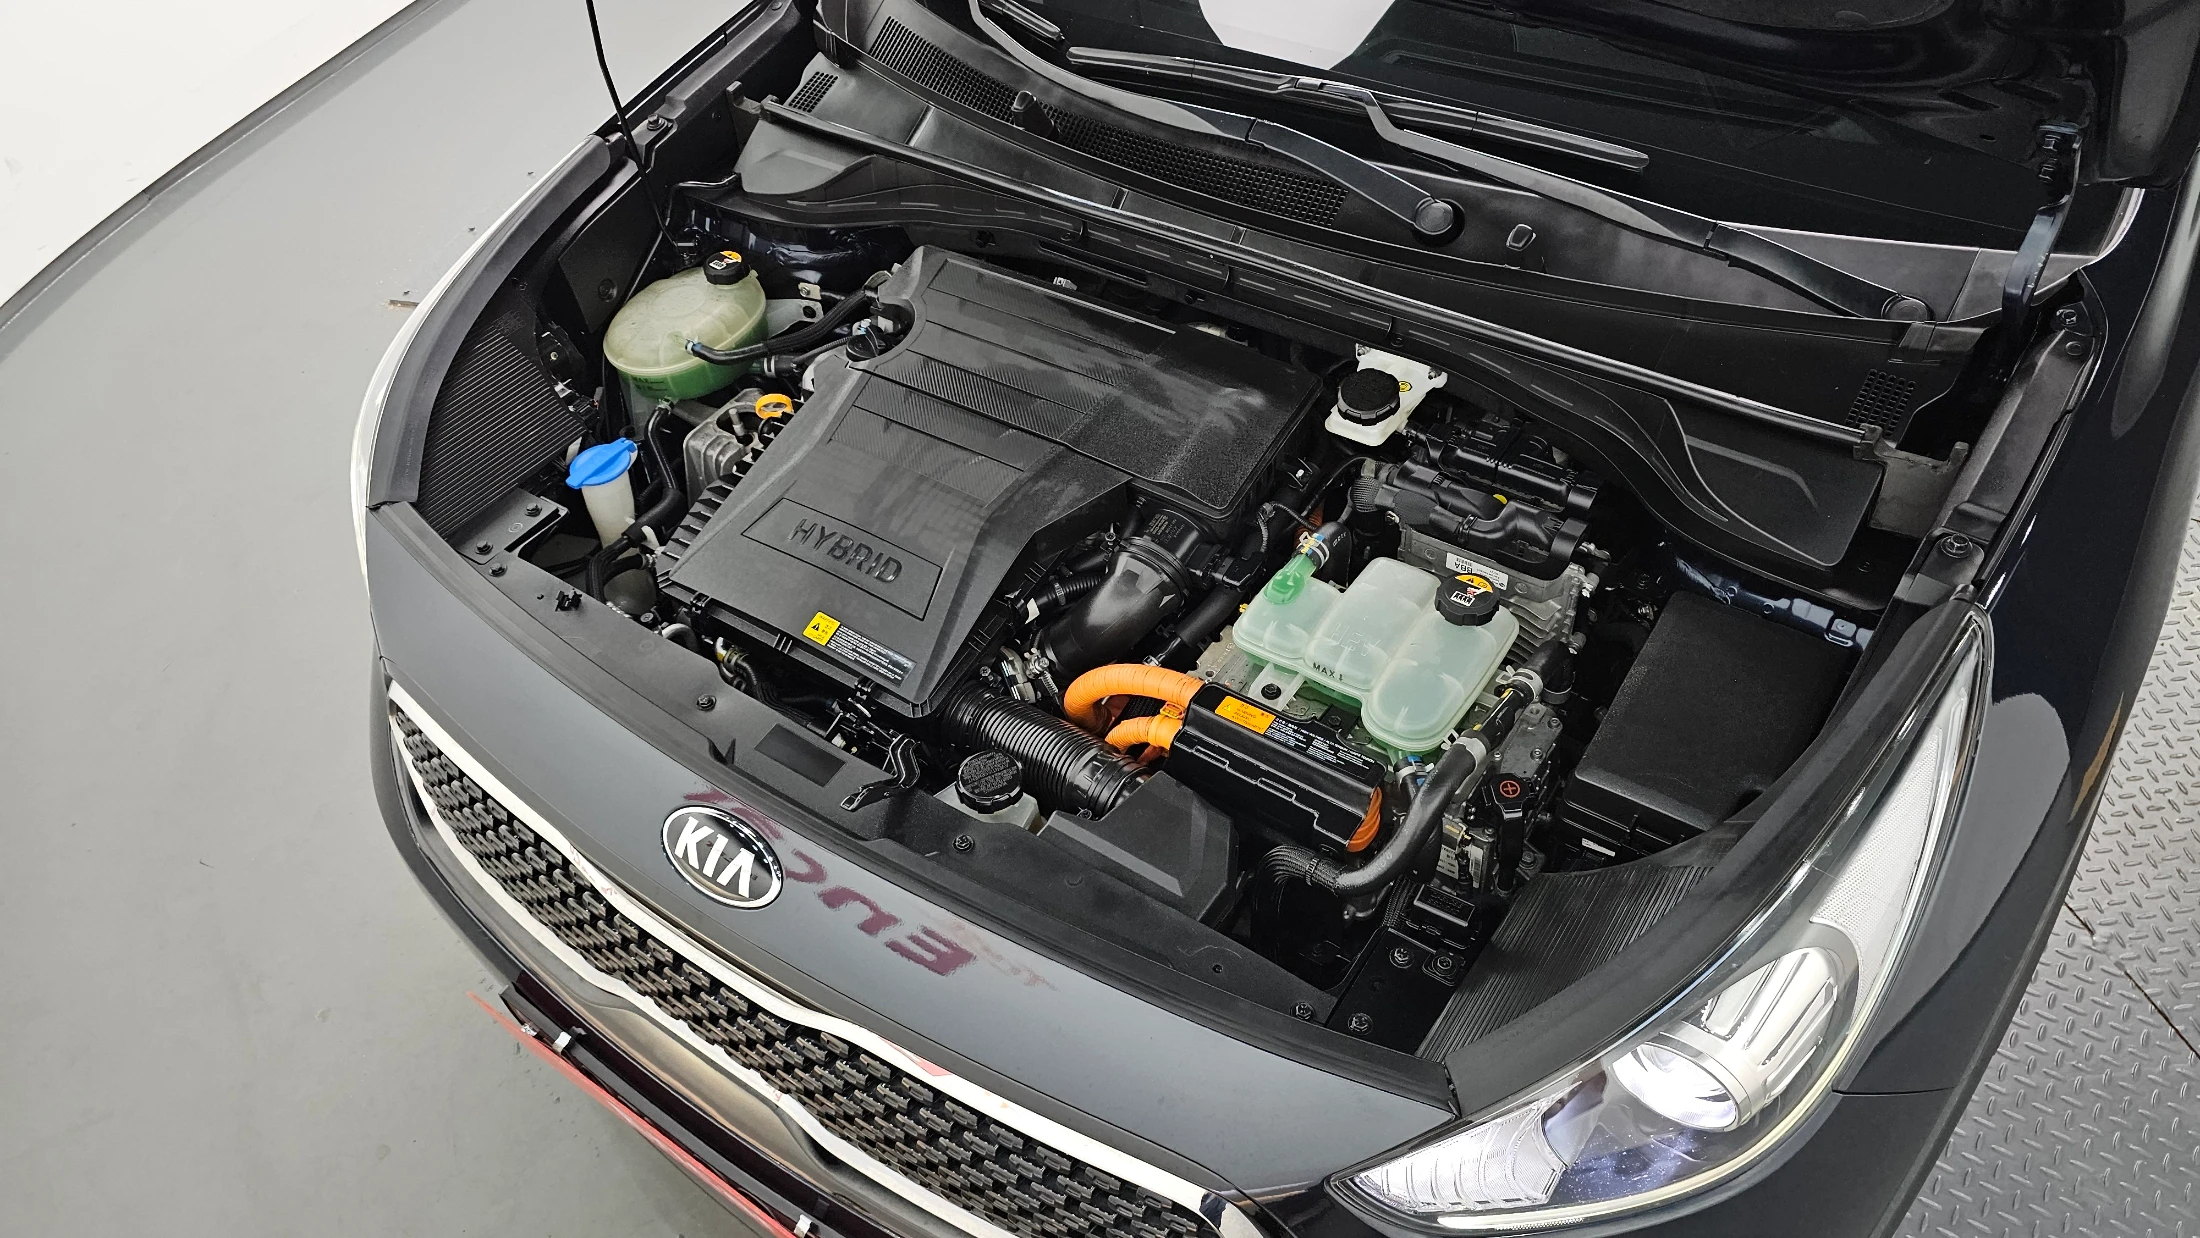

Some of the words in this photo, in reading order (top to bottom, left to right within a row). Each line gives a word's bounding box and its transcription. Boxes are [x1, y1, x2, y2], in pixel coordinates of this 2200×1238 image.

[788, 518, 902, 583] HYBRID
[1312, 661, 1336, 679] MAX
[674, 815, 756, 899] KIA
